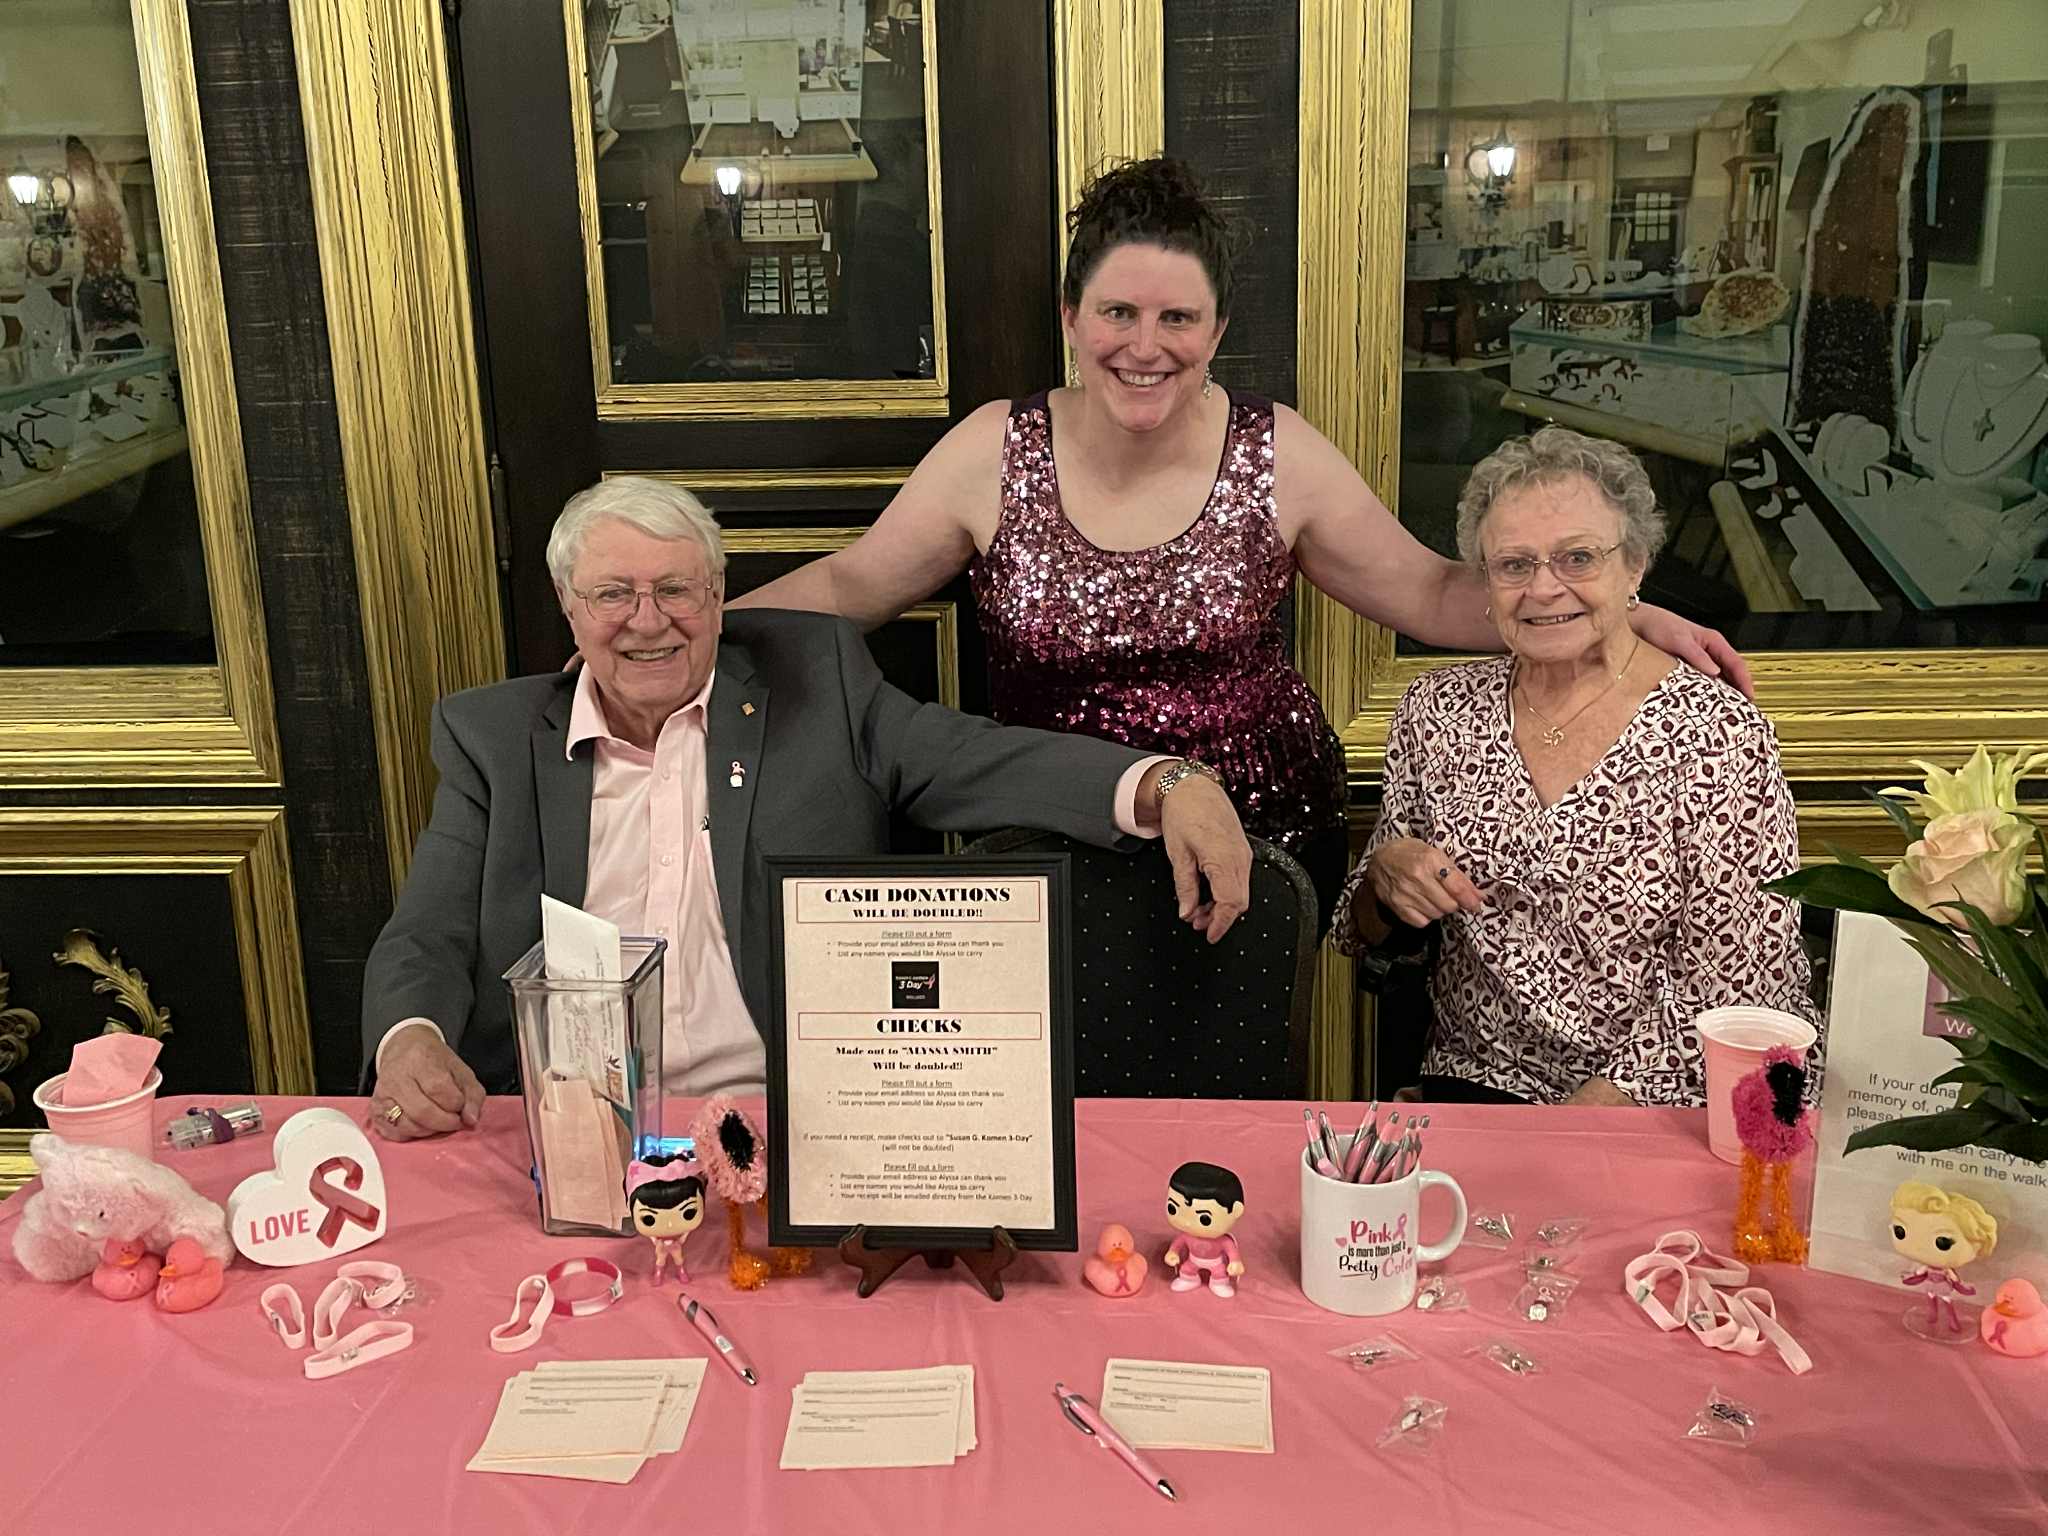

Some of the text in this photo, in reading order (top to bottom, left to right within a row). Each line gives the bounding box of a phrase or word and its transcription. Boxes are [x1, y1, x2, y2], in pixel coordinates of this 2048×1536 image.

[825, 888, 1010, 903] CASH DONATIONS
[853, 909, 983, 917] WILL BE DOUBLED!!
[898, 980, 923, 990] 3 Day
[876, 1019, 962, 1033] CHECKS
[836, 1047, 998, 1055] Made out to "ALYSSA SMITH"
[873, 1062, 963, 1070] Will be doubled!!
[1869, 1073, 1878, 1085] If
[1882, 1077, 1915, 1090] your
[1848, 1089, 1907, 1110] memory
[1912, 1100, 1929, 1114] of,
[1847, 1106, 1894, 1122] please
[849, 1133, 876, 1142] receipt,
[882, 1144, 896, 1152] (will
[923, 1144, 954, 1152] doubled)
[1979, 1148, 2016, 1167] carry
[883, 1163, 955, 1171] Please fill out a form
[1896, 1150, 2048, 1188] with me on the walk
[938, 1183, 958, 1191] Alyssa
[250, 1209, 311, 1245] LOVE
[1351, 1220, 1392, 1244] Pink
[1348, 1244, 1355, 1257] is
[1356, 1248, 1374, 1257] more
[1375, 1245, 1390, 1257] than
[1391, 1241, 1402, 1256] just
[1339, 1254, 1378, 1281] Pretty
